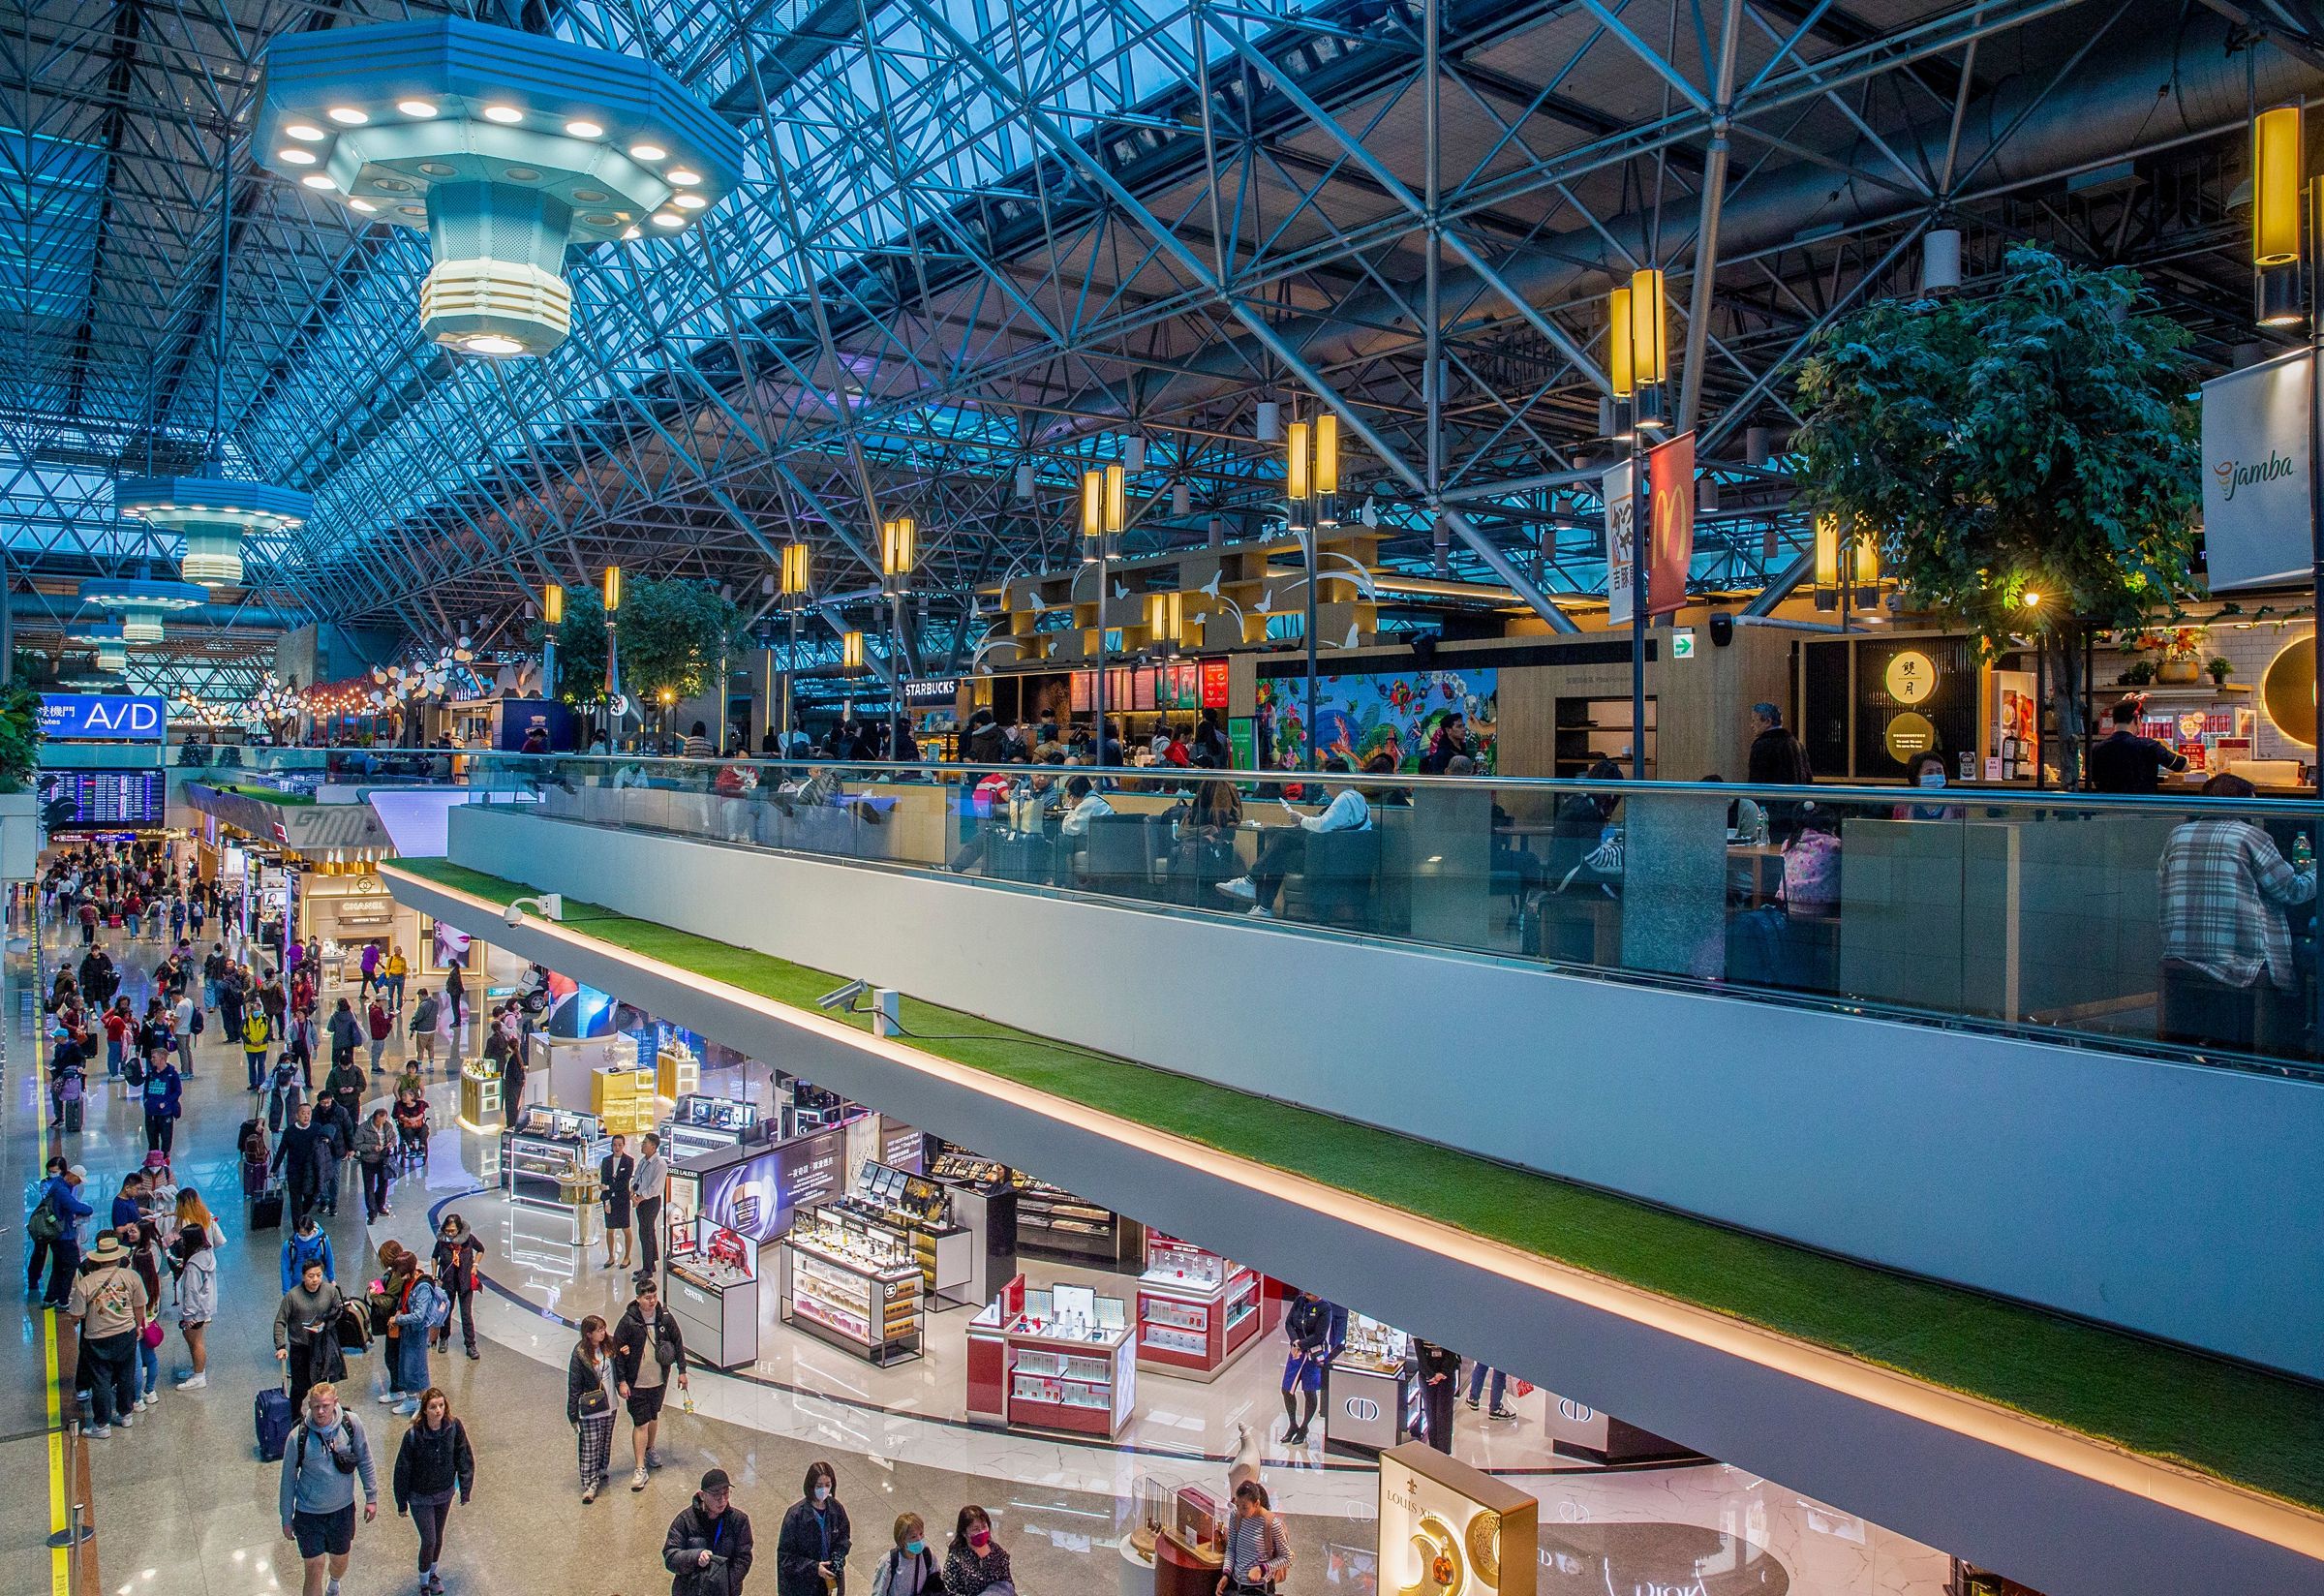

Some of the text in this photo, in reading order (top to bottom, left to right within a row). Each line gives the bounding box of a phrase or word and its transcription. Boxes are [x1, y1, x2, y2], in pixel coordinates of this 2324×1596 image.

[2224, 449, 2294, 502] jamba
[905, 681, 955, 696] STARBUCKS
[83, 702, 157, 730] A/D
[342, 902, 385, 911] CHANEL
[845, 1220, 864, 1233] CHANEL
[1164, 1251, 1171, 1261] 2
[1178, 1253, 1184, 1263] 3
[1207, 1258, 1213, 1267] 5
[1387, 1489, 1418, 1514] LOUIS
